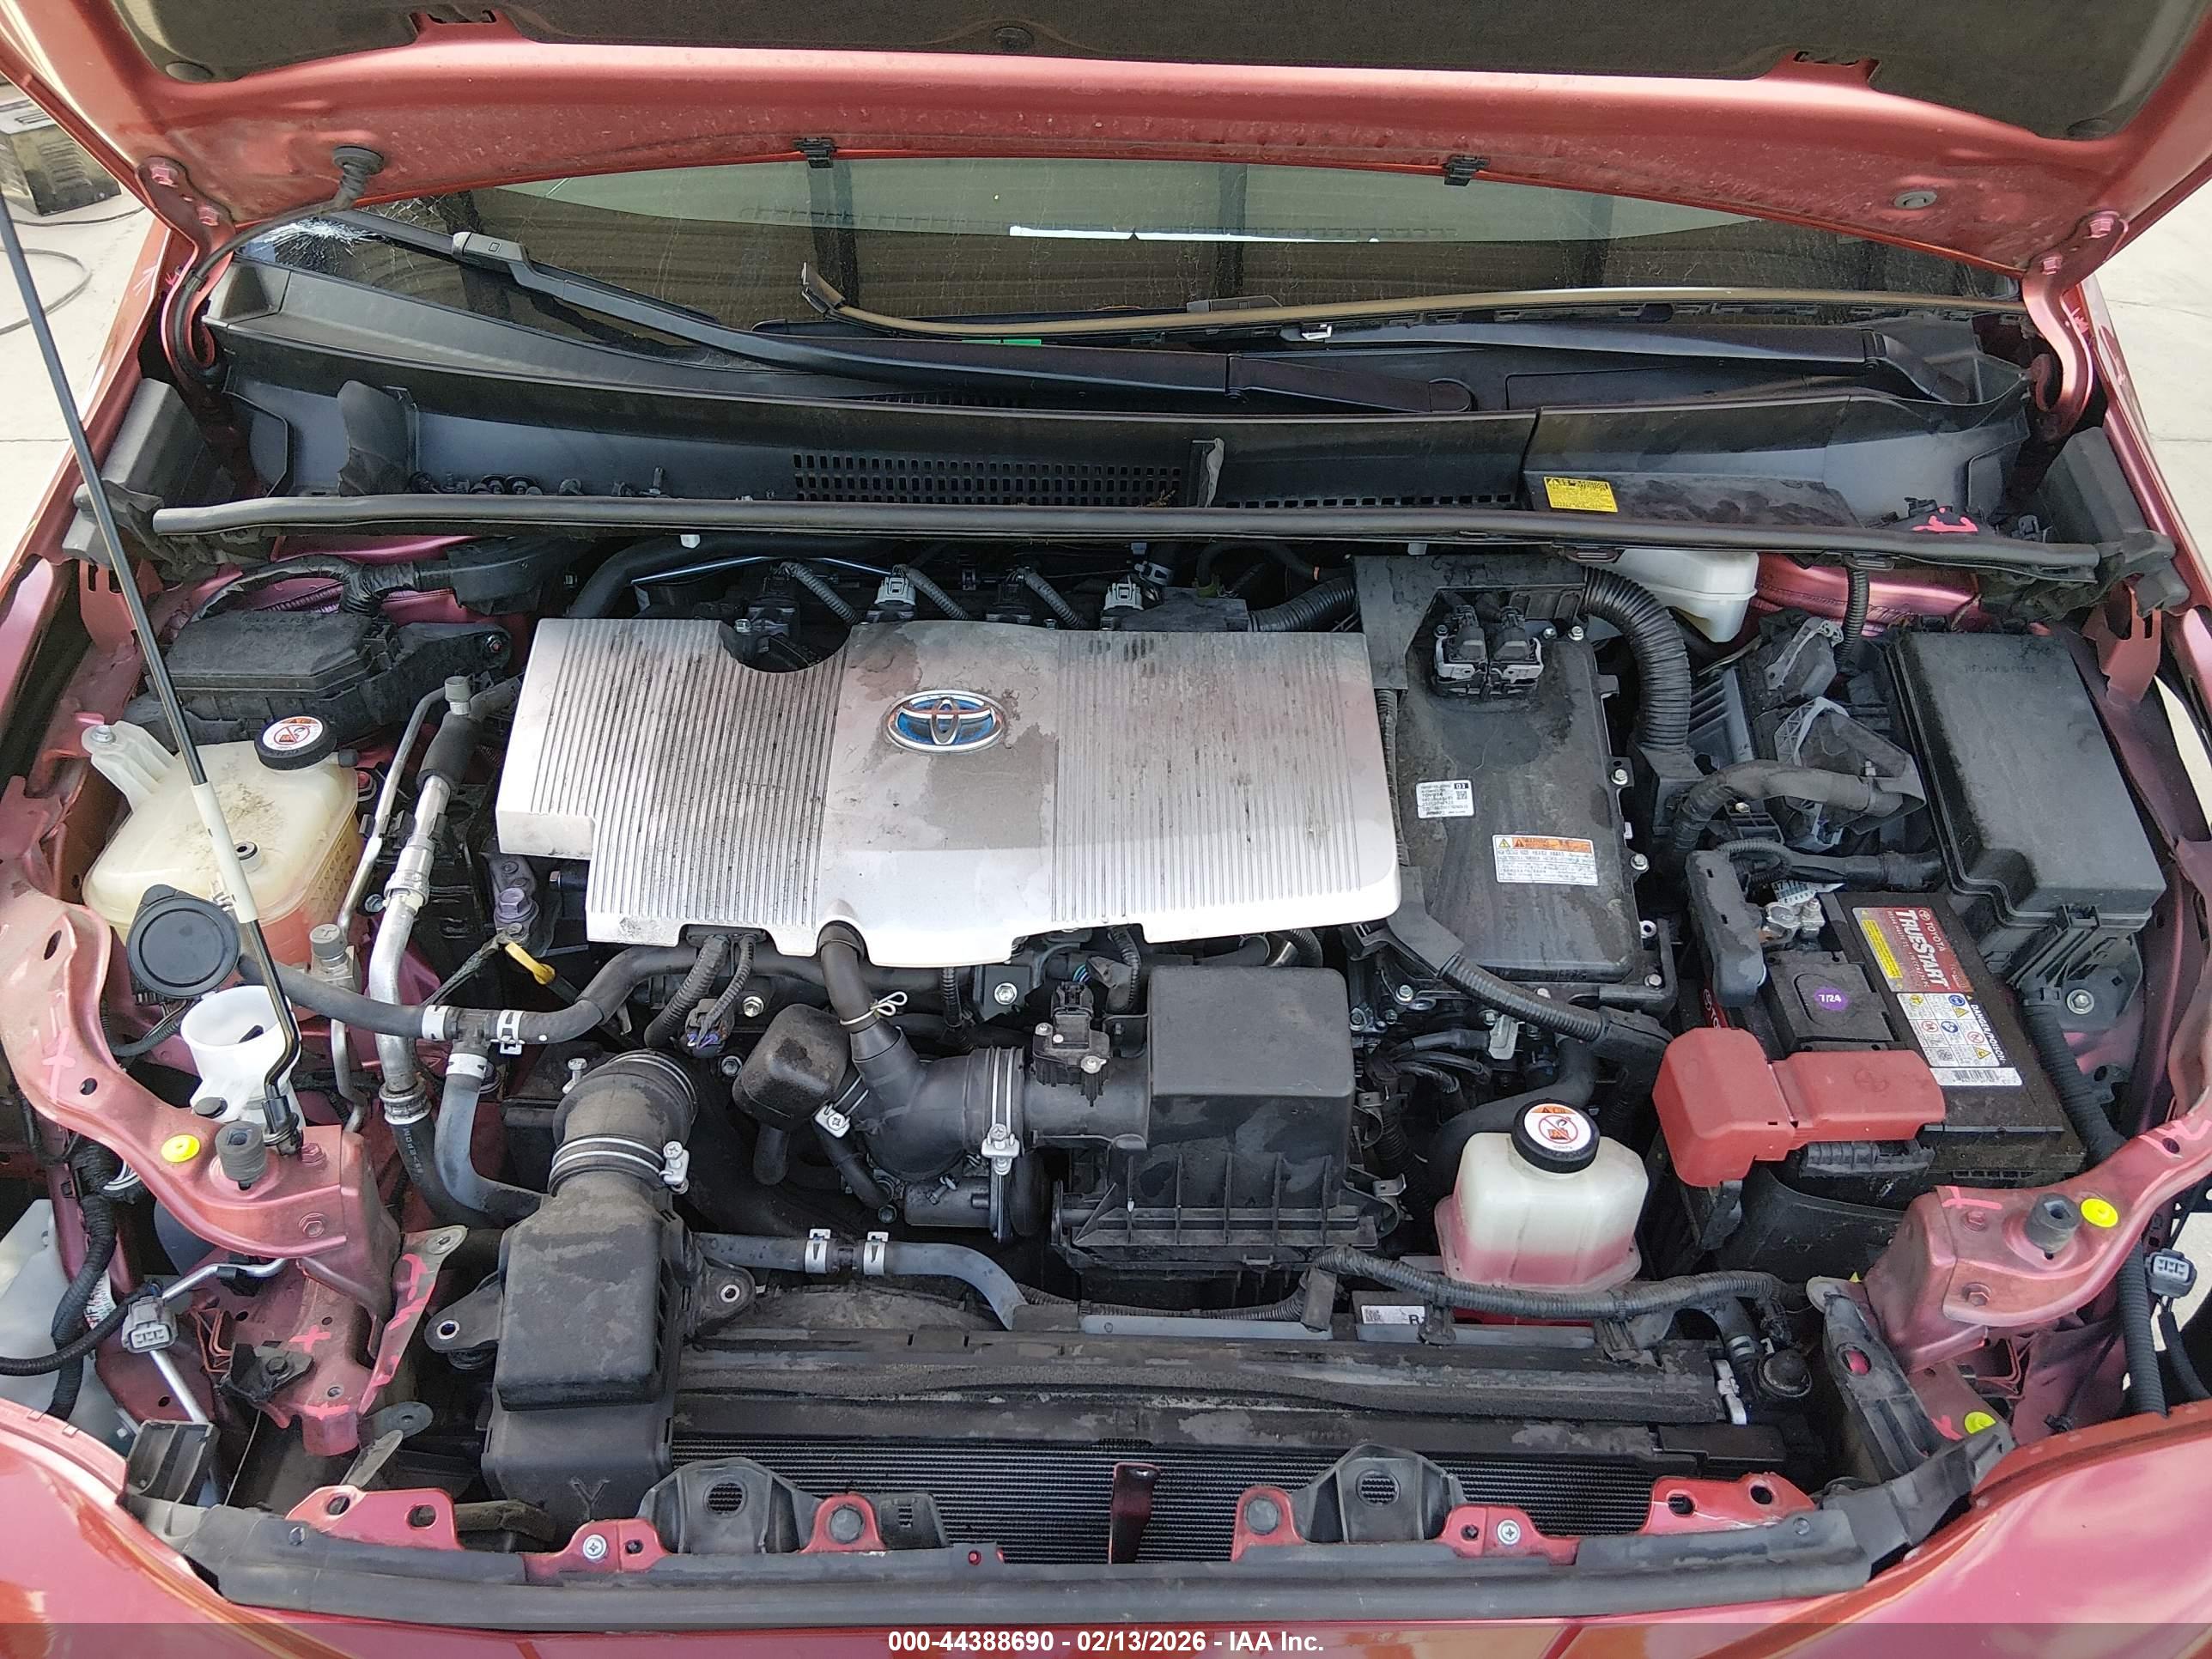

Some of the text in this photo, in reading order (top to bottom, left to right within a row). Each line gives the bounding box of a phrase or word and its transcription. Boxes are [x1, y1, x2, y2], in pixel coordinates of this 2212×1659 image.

[1923, 921, 1947, 952] TOYOTA
[1818, 994, 1842, 1003] 7/24
[1711, 1006, 1722, 1030] TO
[1970, 1004, 2007, 1062] DANGER/POISON
